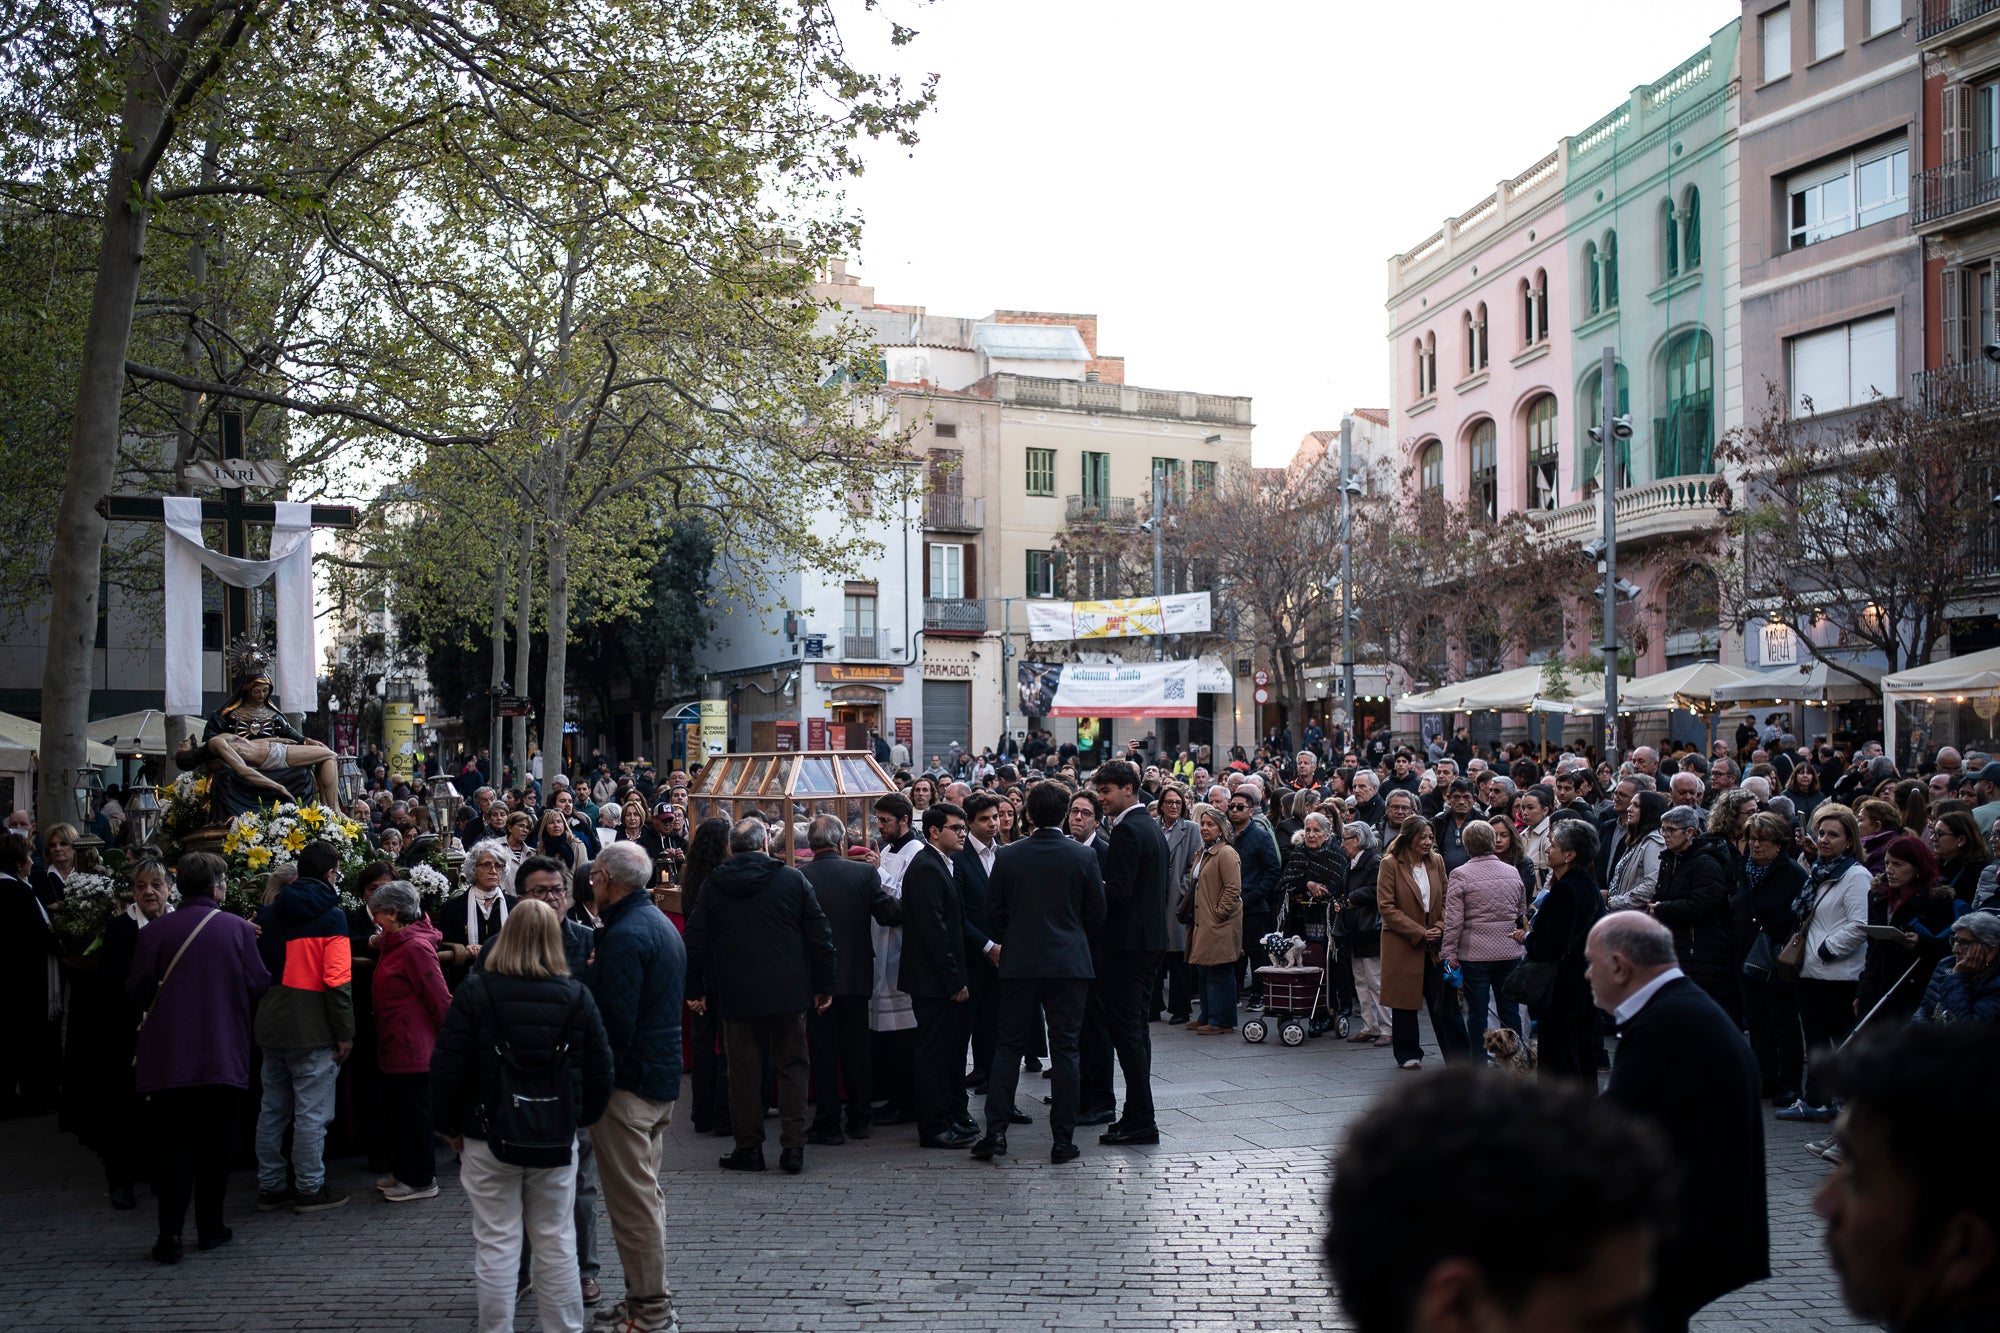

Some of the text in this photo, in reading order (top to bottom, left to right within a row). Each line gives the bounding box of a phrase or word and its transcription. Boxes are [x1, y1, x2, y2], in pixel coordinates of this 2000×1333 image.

[1107, 615, 1128, 624] MAGIC
[1105, 623, 1120, 631] LINE
[849, 667, 890, 676] TABACS
[924, 665, 970, 677] FARMACIA
[1070, 666, 1141, 681] Setmana Santa
